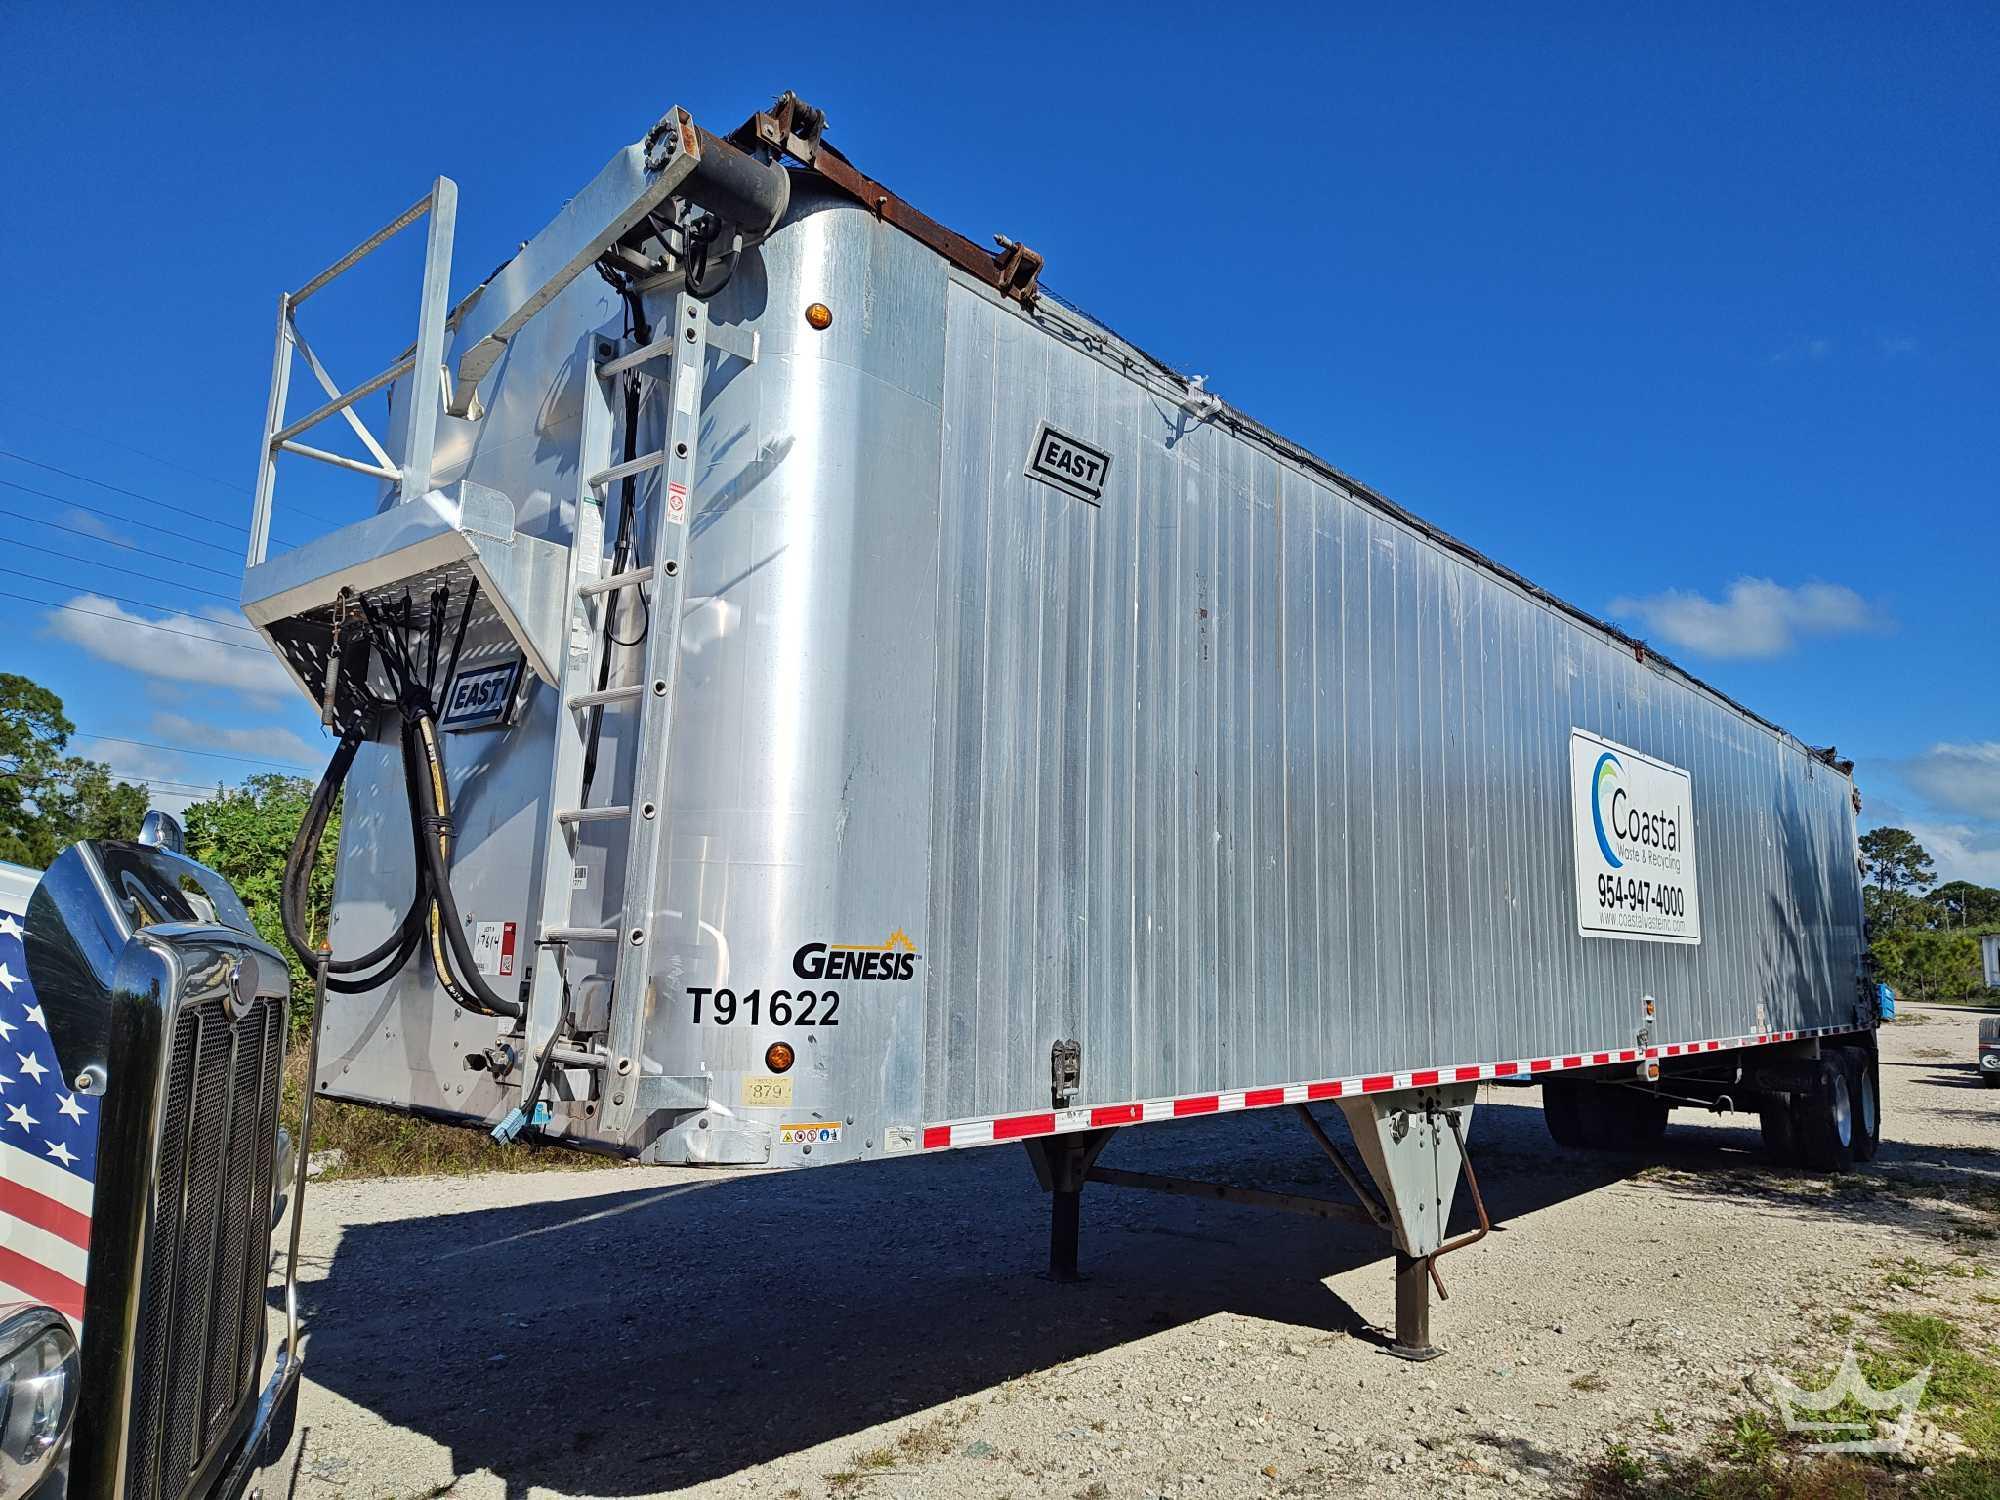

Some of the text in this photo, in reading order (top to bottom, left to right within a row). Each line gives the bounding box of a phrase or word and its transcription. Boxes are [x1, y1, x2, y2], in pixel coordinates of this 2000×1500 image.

[1044, 441, 1100, 482] EAST
[454, 677, 505, 710] EAST
[1612, 788, 1681, 852] Coastal
[1617, 844, 1640, 863] Waste
[1648, 850, 1681, 874] Recycling
[1598, 873, 1685, 918] 954-947-4000
[793, 942, 915, 981] GENESIS
[686, 987, 840, 1026] T91622
